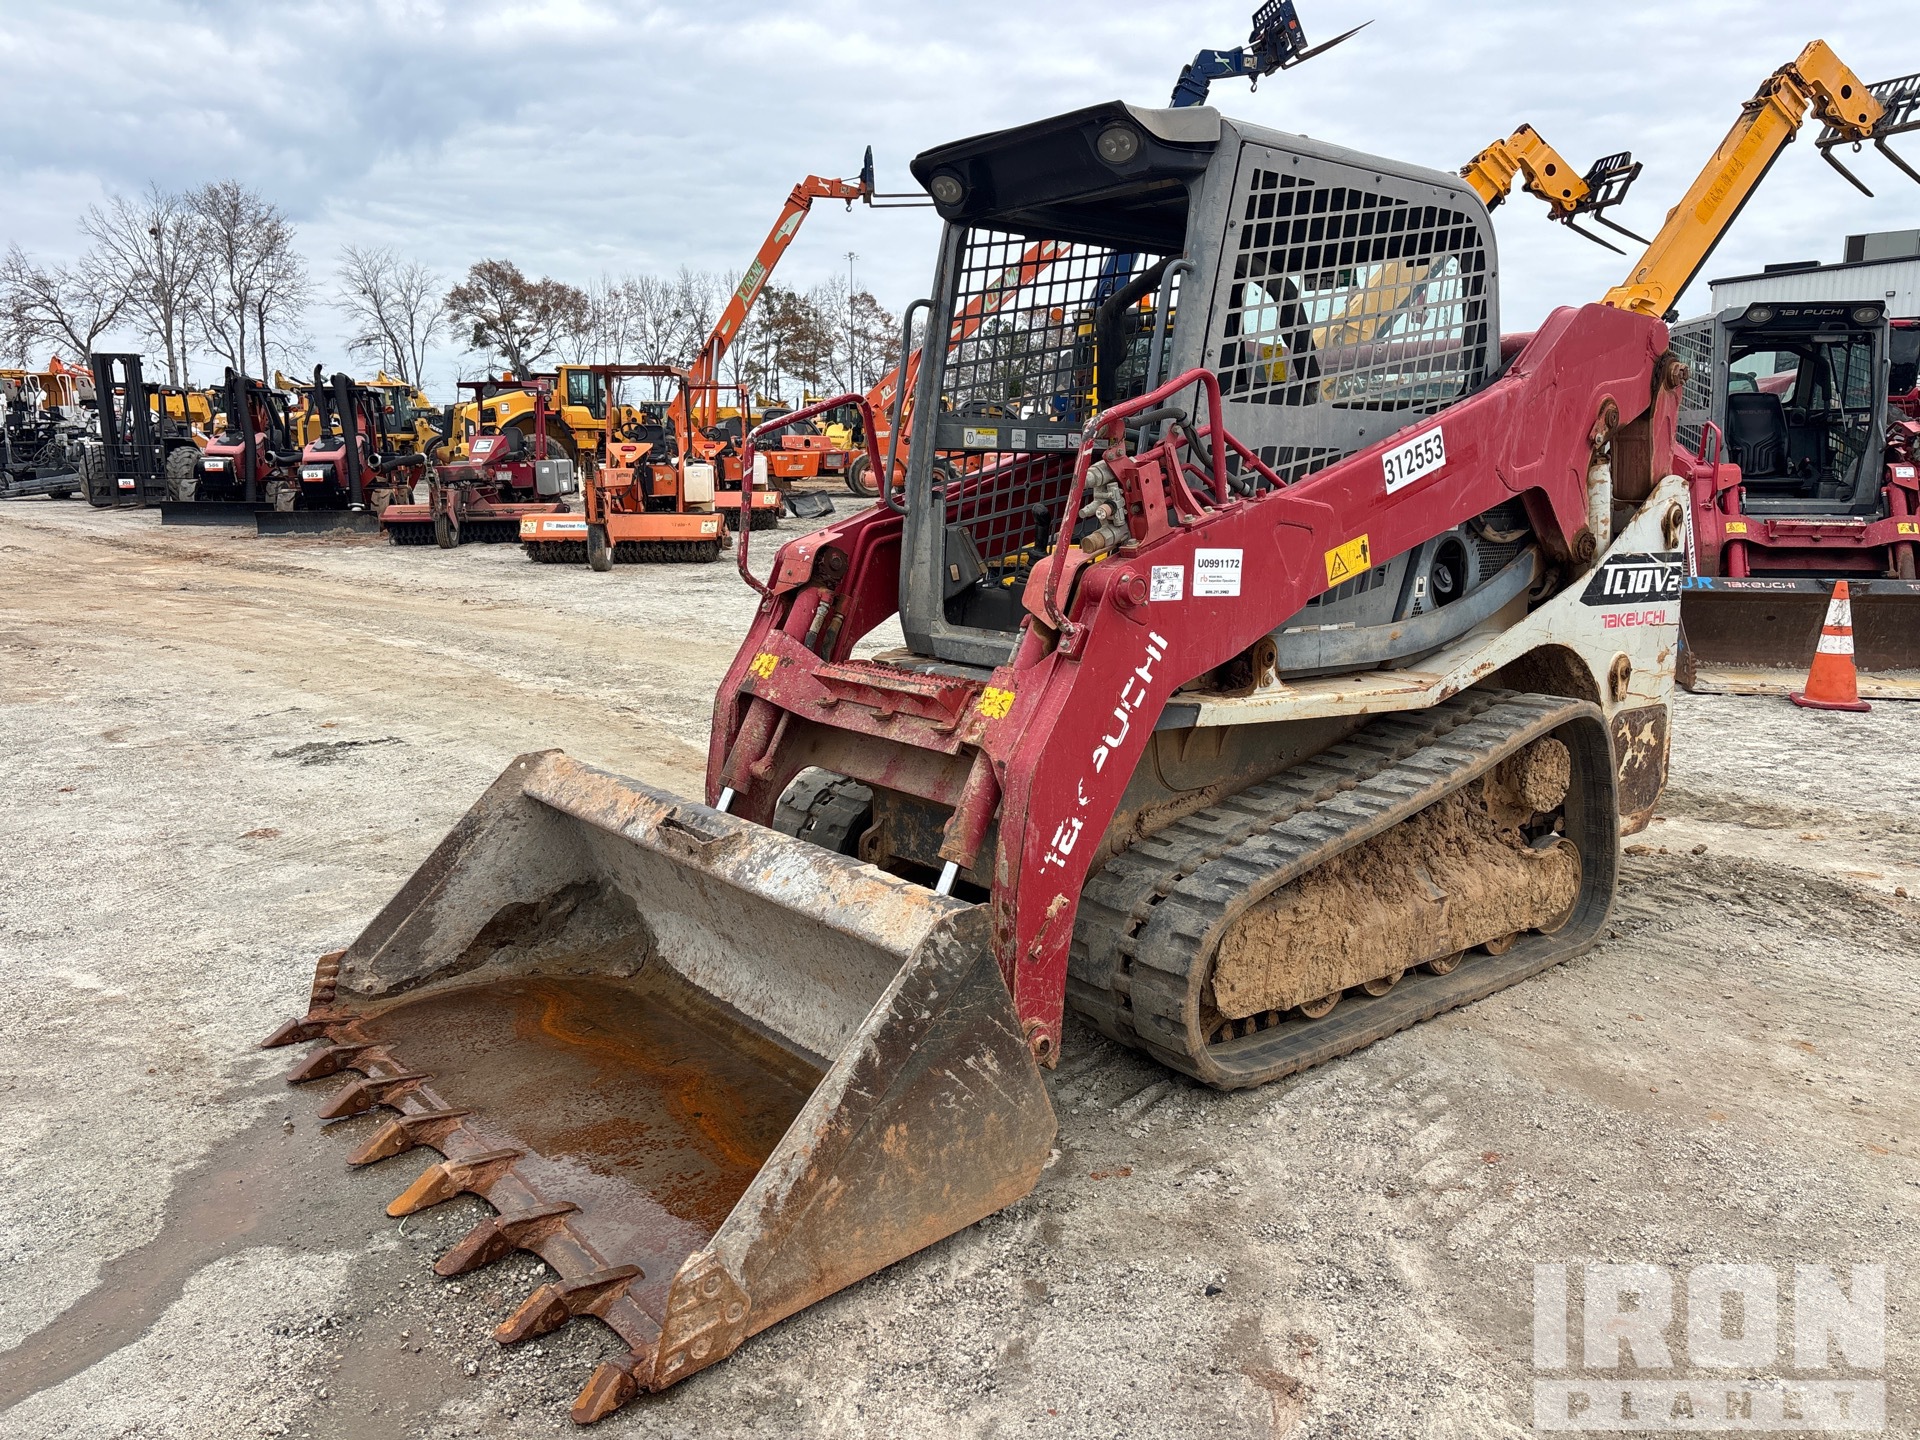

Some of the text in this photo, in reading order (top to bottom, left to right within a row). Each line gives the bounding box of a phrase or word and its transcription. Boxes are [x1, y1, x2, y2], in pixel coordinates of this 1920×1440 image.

[1384, 434, 1443, 485] 312553
[1198, 559, 1240, 568] U0991172
[1603, 562, 1681, 595] TL10V2
[1723, 581, 1796, 589] TAKEUCHI
[1601, 610, 1665, 628] TAKEUCHI
